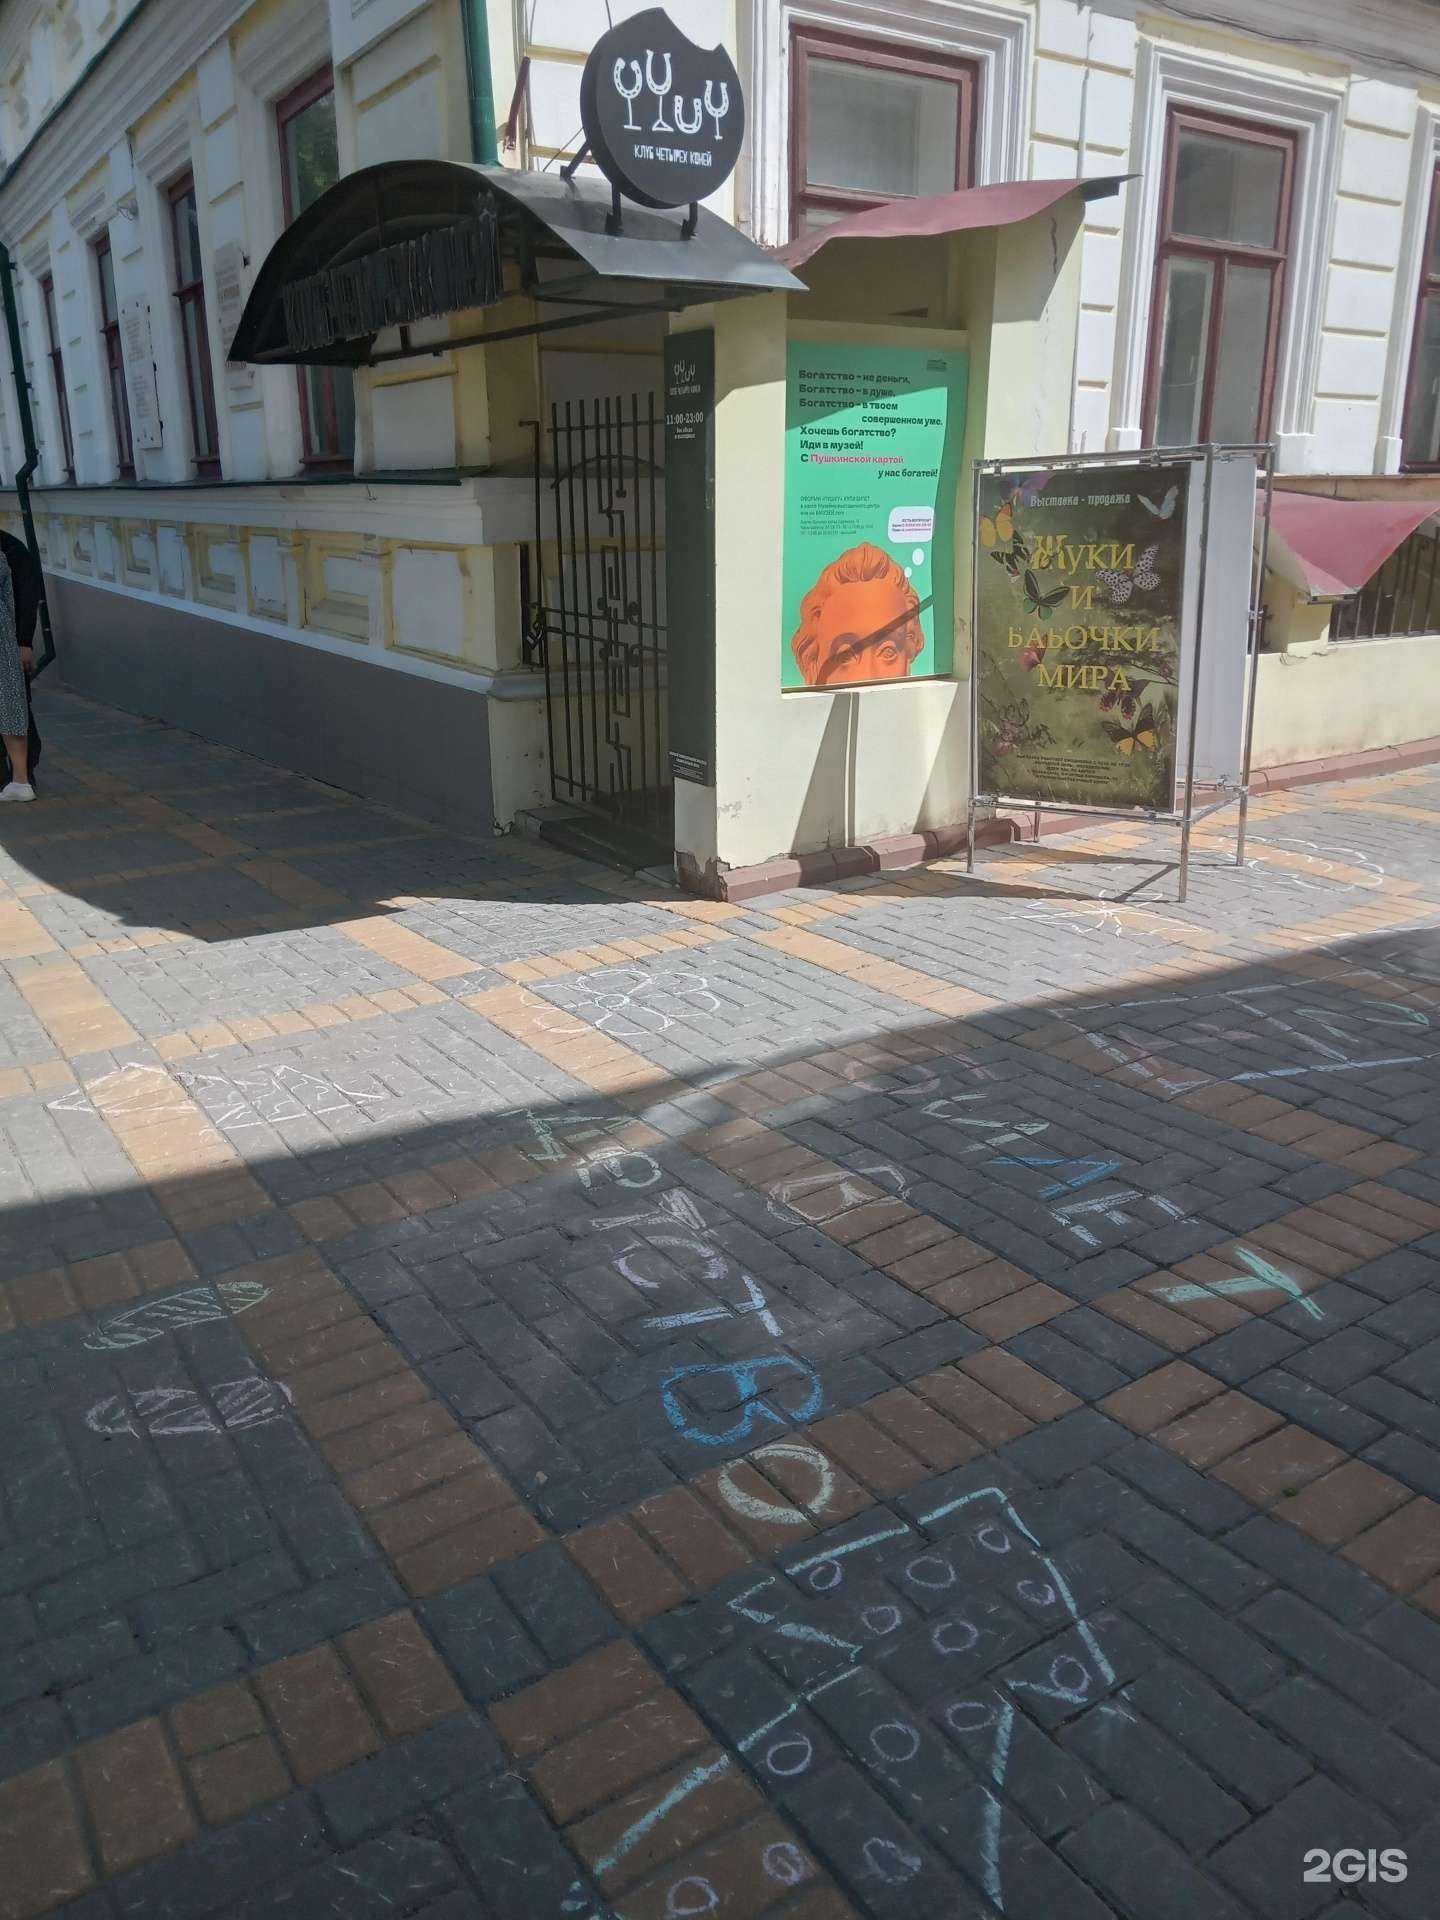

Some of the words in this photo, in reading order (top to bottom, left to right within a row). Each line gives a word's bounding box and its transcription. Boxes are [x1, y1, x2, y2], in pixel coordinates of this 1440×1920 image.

[634, 144, 655, 160] КЛУБ
[656, 147, 688, 165] ЧЕТЫРЕХ
[690, 151, 712, 167] КОНЕЙ
[799, 369, 855, 381] Богатство
[875, 376, 911, 384] деньги,
[799, 384, 855, 395] Богатство
[799, 399, 855, 409] Богатство
[862, 415, 924, 426] совершенном
[924, 418, 943, 427] уме.
[800, 426, 840, 436] Хочешь
[842, 426, 896, 437] богатство?
[800, 441, 821, 451] Иди
[830, 441, 864, 451] музей!
[800, 454, 809, 463] С
[810, 454, 871, 464] Пушкинской
[872, 455, 904, 464] картой
[901, 468, 938, 477] богатей!
[1030, 495, 1079, 507] Выставка
[1088, 494, 1130, 506] продажа
[1035, 664, 1132, 691] МИРА
